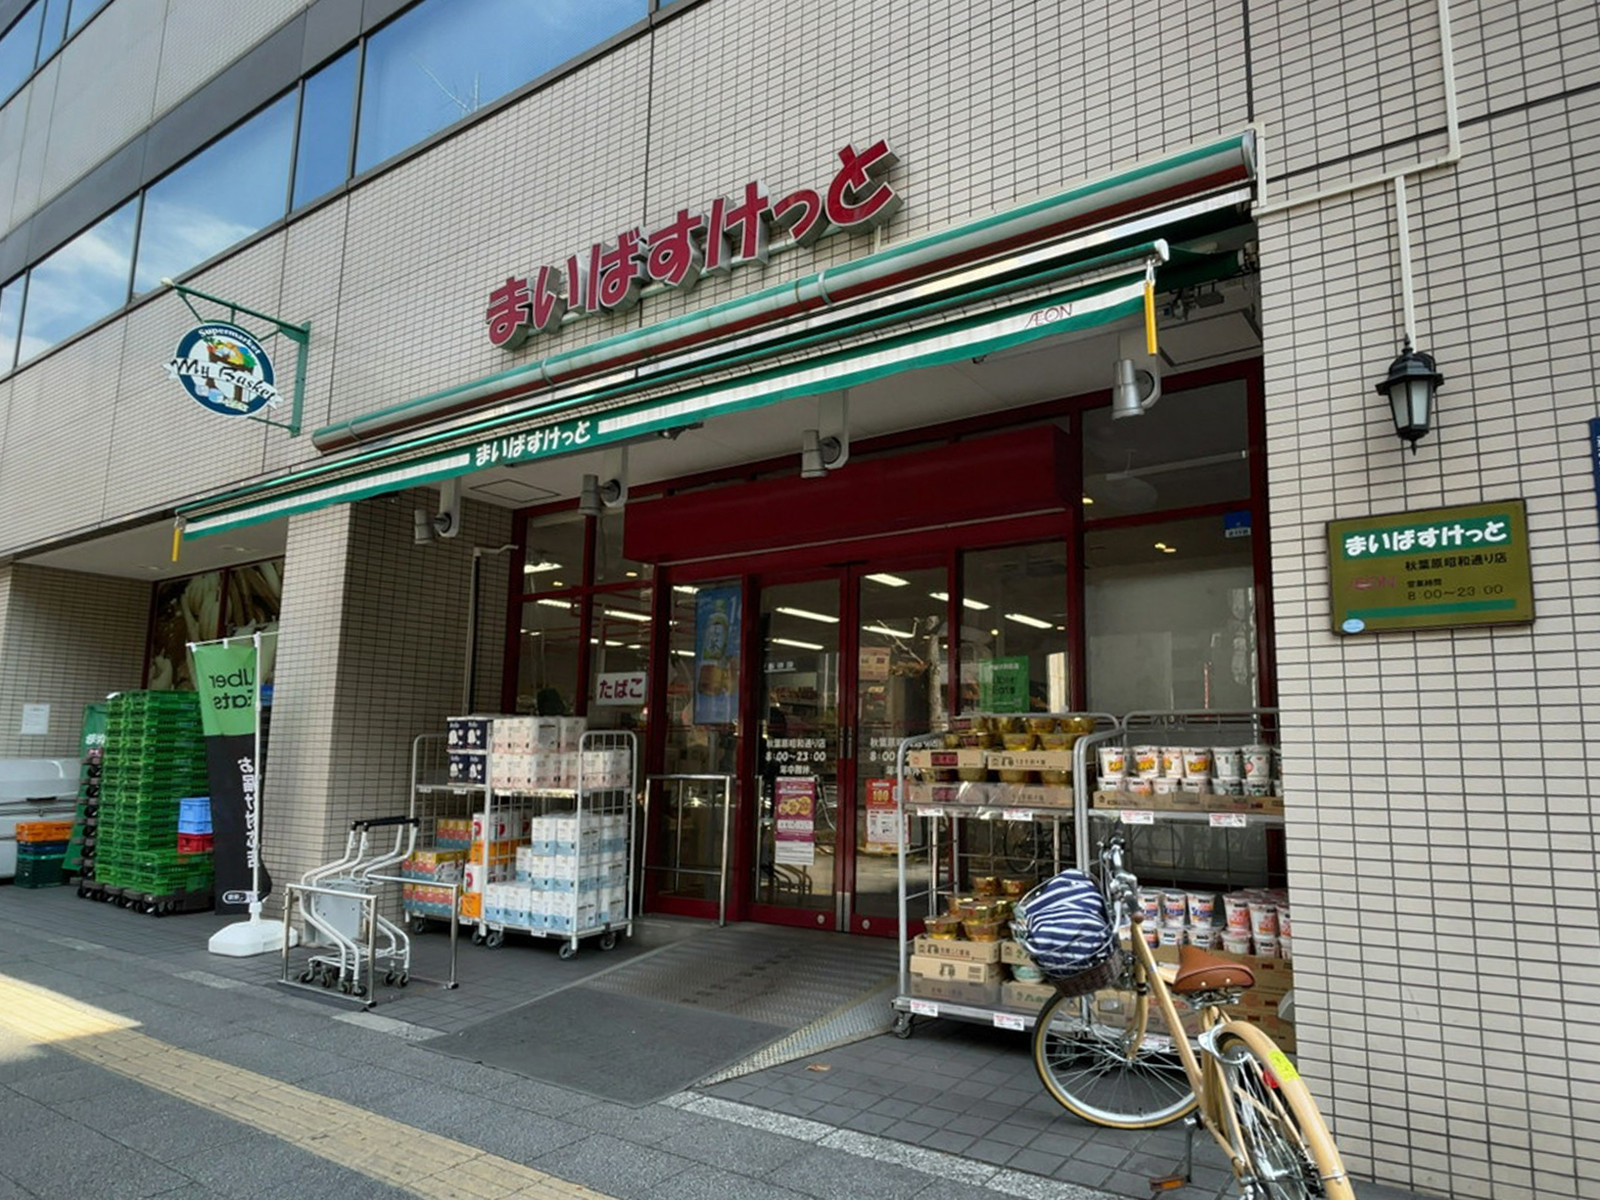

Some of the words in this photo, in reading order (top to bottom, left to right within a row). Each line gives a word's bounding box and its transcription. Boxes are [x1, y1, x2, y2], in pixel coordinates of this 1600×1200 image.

[486, 139, 894, 347] まいばすけっと
[198, 327, 262, 354] Supermarket
[170, 359, 210, 379] My
[219, 366, 276, 401] Basket
[475, 420, 591, 467] まいばすけっと
[1345, 521, 1507, 556] まいばすけっと
[1405, 552, 1508, 571] 秋葉原昭和通り店
[1407, 578, 1442, 588] 営業時間
[599, 678, 643, 699] たばこ
